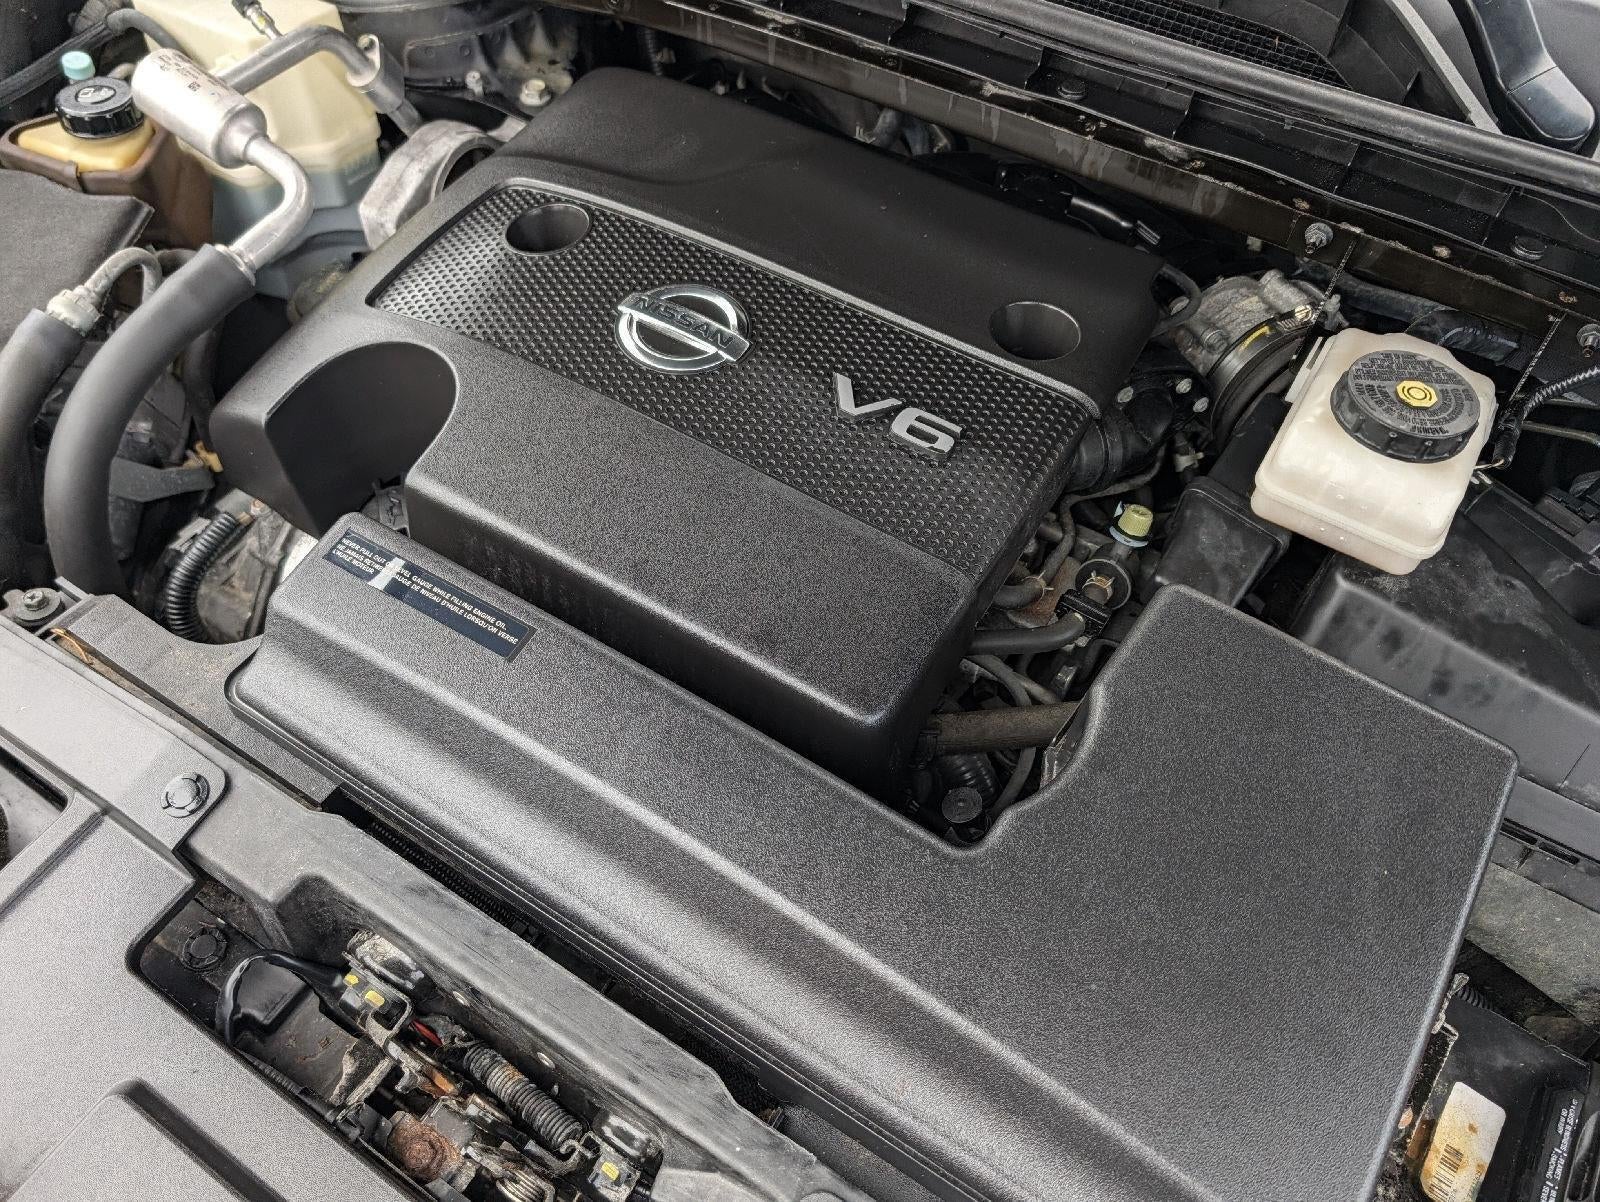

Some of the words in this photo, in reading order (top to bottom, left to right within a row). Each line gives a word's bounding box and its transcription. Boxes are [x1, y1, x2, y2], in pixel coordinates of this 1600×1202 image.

[638, 297, 733, 348] NISSAN
[832, 372, 963, 453] V6
[341, 537, 360, 550] NEVER
[359, 547, 373, 557] PULL
[372, 554, 387, 564] OUT
[411, 574, 433, 589] GAUGE
[432, 586, 451, 599] WHILE
[450, 595, 473, 611] FILLING
[472, 607, 496, 623] ENGINE
[344, 547, 364, 561] JAMAIS
[410, 583, 420, 591] DE
[419, 588, 441, 603] NIVEAU
[440, 599, 464, 615] D'HUILE
[497, 630, 518, 644] VERSE
[351, 558, 375, 574] MOTEUR
